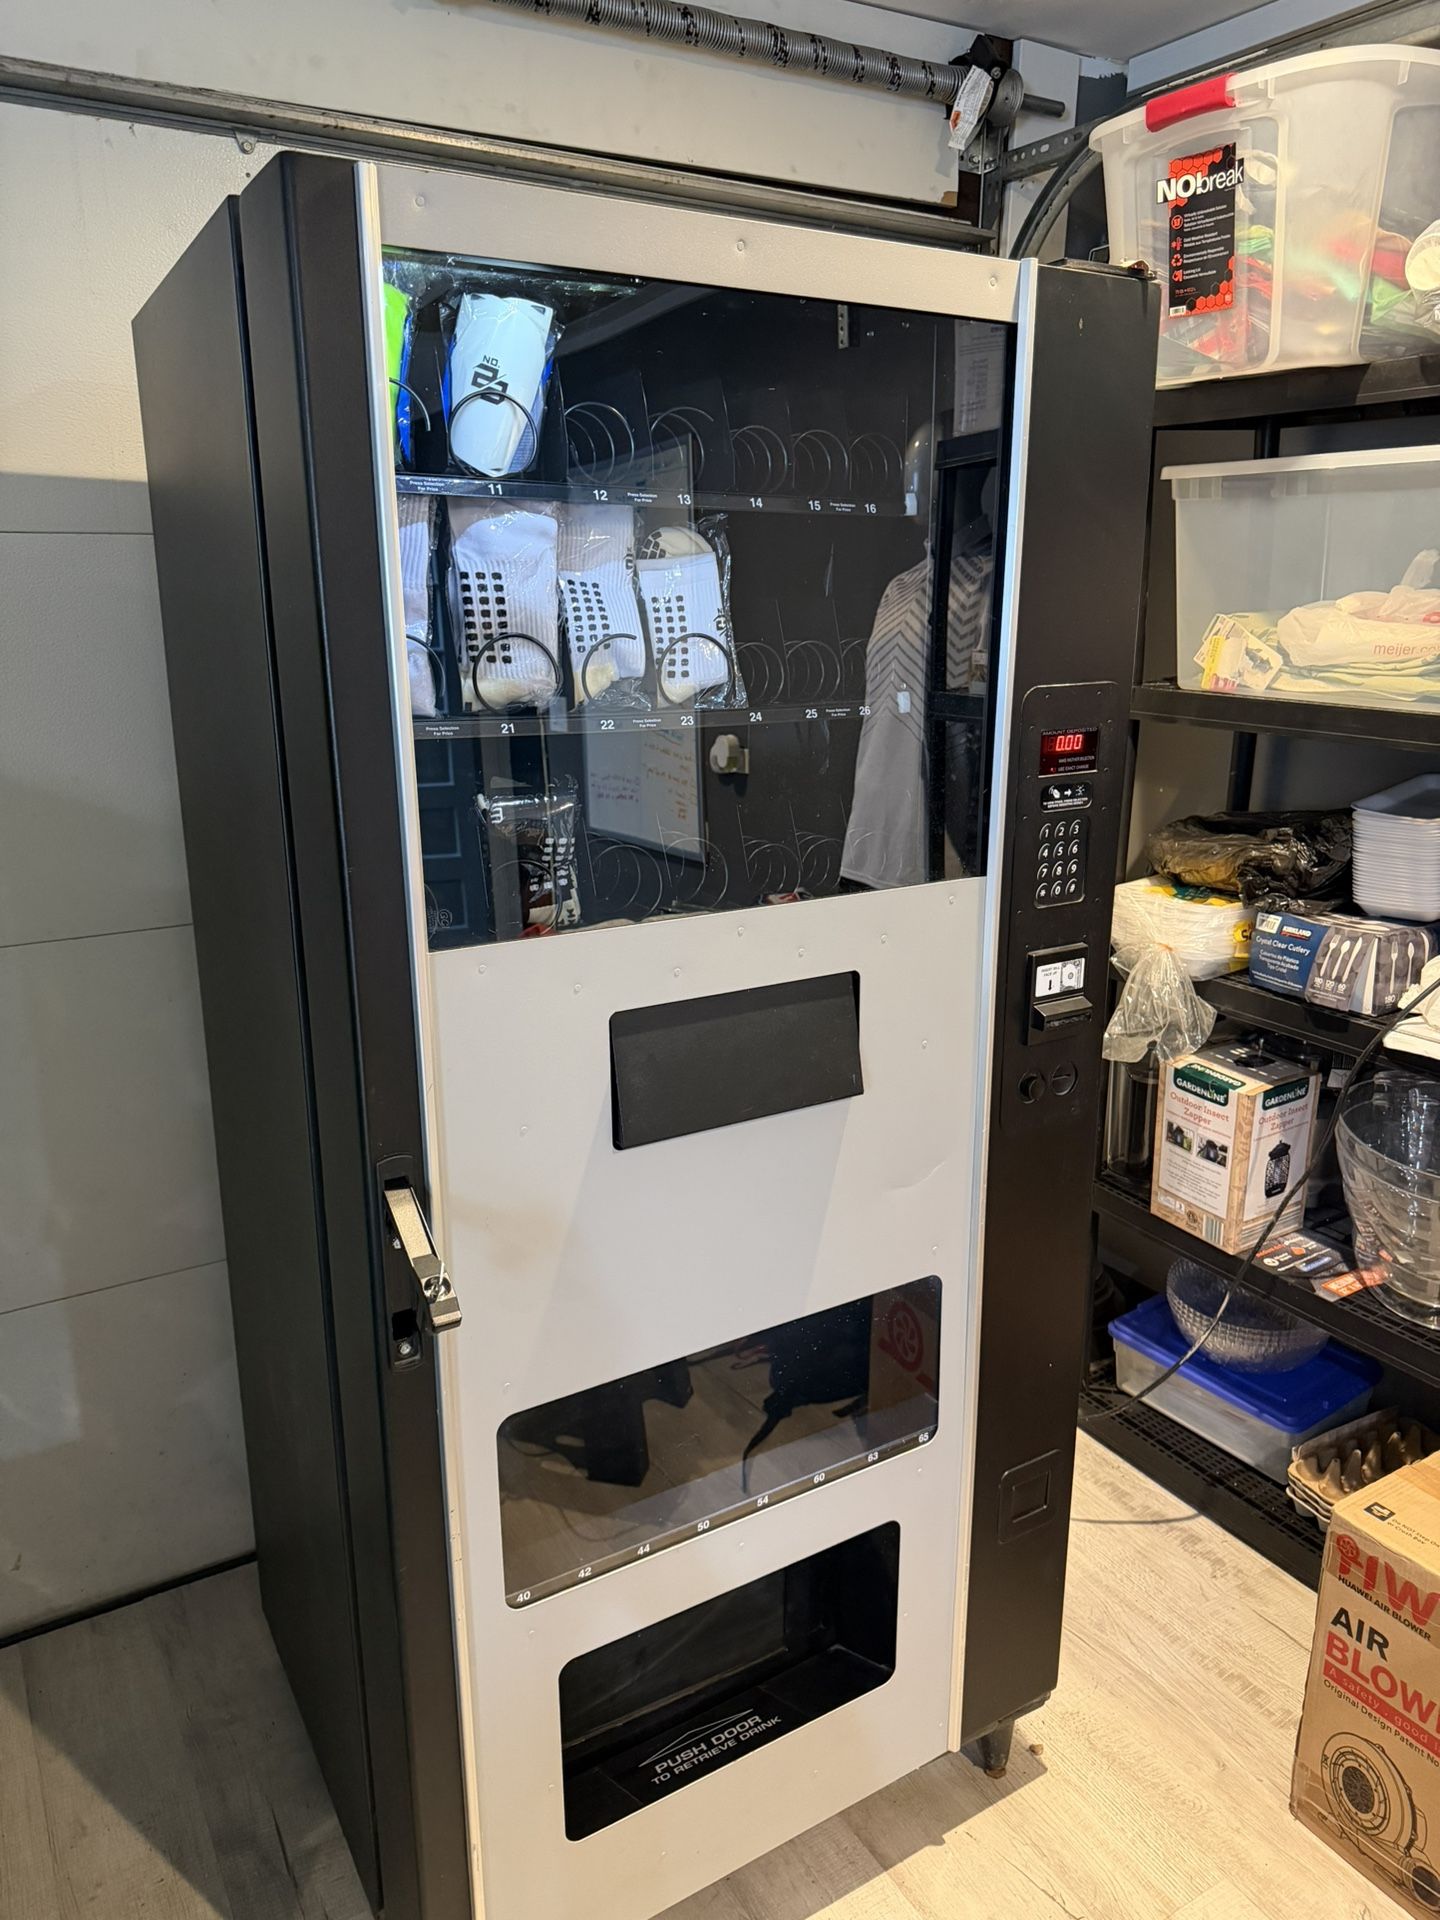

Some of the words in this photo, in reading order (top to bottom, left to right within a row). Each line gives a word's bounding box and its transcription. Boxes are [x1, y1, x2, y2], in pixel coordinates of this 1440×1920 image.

[1157, 161, 1243, 203] NO!break
[483, 355, 501, 368] NO.
[488, 483, 503, 495] 11
[593, 490, 608, 501] 12
[677, 494, 691, 505] 13
[750, 497, 763, 508] 14
[808, 501, 821, 511] 15
[864, 503, 877, 513] 16
[750, 712, 762, 722] 24
[805, 709, 818, 719] 25
[859, 706, 871, 716] 26
[600, 720, 615, 730] 22
[680, 716, 694, 726] 23
[501, 723, 515, 734] 21
[1056, 734, 1083, 751] 0.00
[1044, 829, 1049, 838] 1
[1059, 827, 1064, 836] 2
[1074, 825, 1079, 834] 3
[1042, 849, 1048, 857] 4
[1058, 847, 1063, 856] 5
[1072, 844, 1078, 854] 6
[1042, 869, 1047, 878] 7
[1056, 866, 1062, 875] 8
[1071, 864, 1077, 873] 9
[1055, 886, 1060, 895] 0
[1272, 940, 1287, 949] Clear
[1288, 944, 1311, 956] Cutlery
[1176, 1078, 1227, 1103] GARDENLINE
[1265, 1085, 1308, 1107] GARDENLINE
[1170, 1092, 1202, 1111] Outdoor
[1203, 1106, 1229, 1122] Insect
[1184, 1107, 1212, 1126] Zapper
[1259, 1111, 1287, 1125] Outdoor
[1288, 1104, 1308, 1115] Insect
[1271, 1118, 1294, 1131] Zapper
[918, 1432, 929, 1443] 65
[867, 1451, 879, 1462] 63
[813, 1472, 825, 1483] 60
[756, 1495, 769, 1507] 54
[697, 1518, 710, 1531] 50
[1402, 1523, 1416, 1533] NOT
[637, 1543, 651, 1556] 44
[578, 1566, 592, 1578] 42
[516, 1590, 531, 1603] 40
[1338, 1575, 1373, 1602] HUAWEI
[1374, 1599, 1391, 1615] AIR
[1391, 1610, 1431, 1641] BLOWER
[1331, 1607, 1389, 1662] AIR
[1326, 1631, 1440, 1734] BLOW
[1328, 1667, 1337, 1678] A
[1342, 1678, 1380, 1710] safety
[1394, 1715, 1428, 1744] good
[1323, 1679, 1359, 1710] Original
[1361, 1707, 1392, 1734] Design
[1394, 1729, 1426, 1758] Patent
[651, 1772, 671, 1785] TO
[673, 1738, 737, 1775] RETRIEVE
[739, 1716, 782, 1741] DRINK
[655, 1742, 708, 1774] PUSH
[711, 1715, 762, 1746] DOOR
